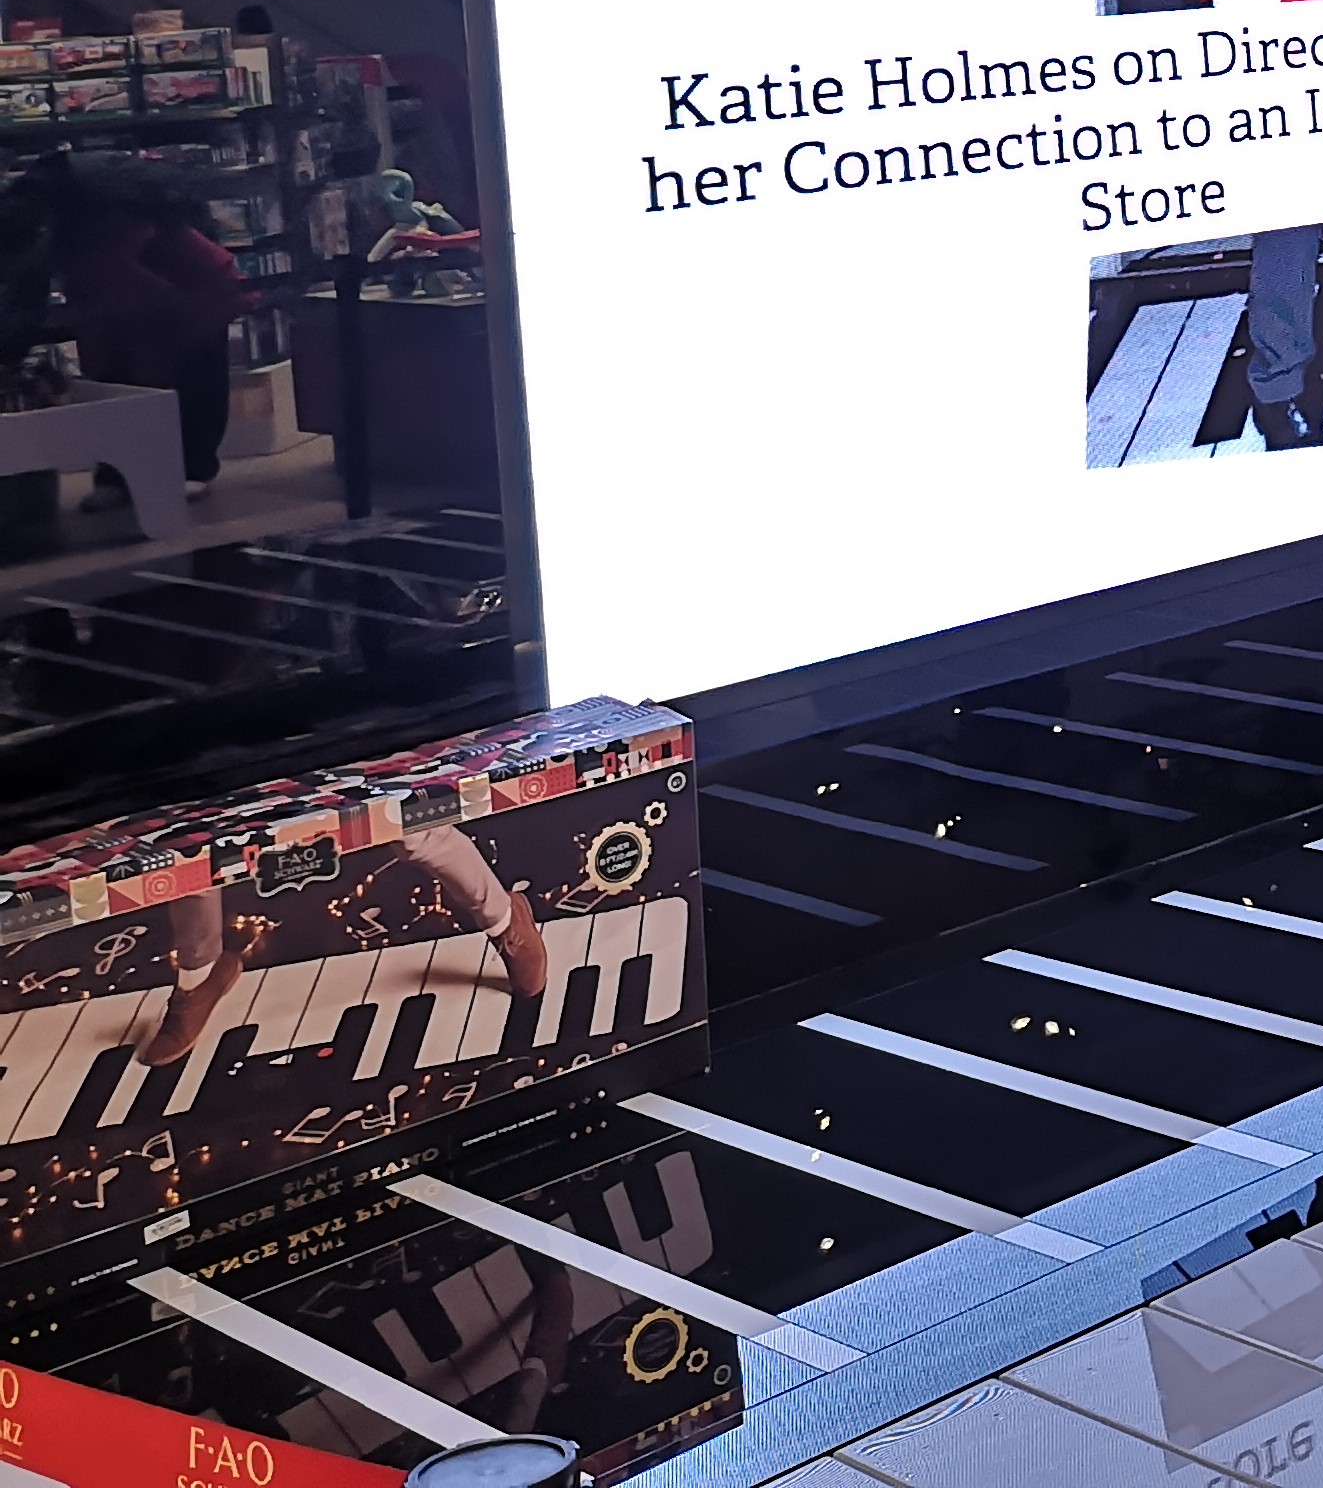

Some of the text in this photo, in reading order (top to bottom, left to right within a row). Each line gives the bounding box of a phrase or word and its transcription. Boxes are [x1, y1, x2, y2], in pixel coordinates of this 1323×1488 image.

[661, 61, 845, 131] Katie
[864, 50, 1097, 111] Holmes
[1114, 48, 1184, 86] on
[641, 156, 764, 213] her
[783, 113, 1144, 194] Connection
[1156, 109, 1212, 152] to
[1228, 105, 1292, 143] an
[1081, 180, 1227, 232] Store
[175, 1205, 276, 1251] DANCE
[284, 1180, 344, 1212] MAT
[353, 1147, 440, 1188] PIANO
[282, 1165, 340, 1195] GIANT
